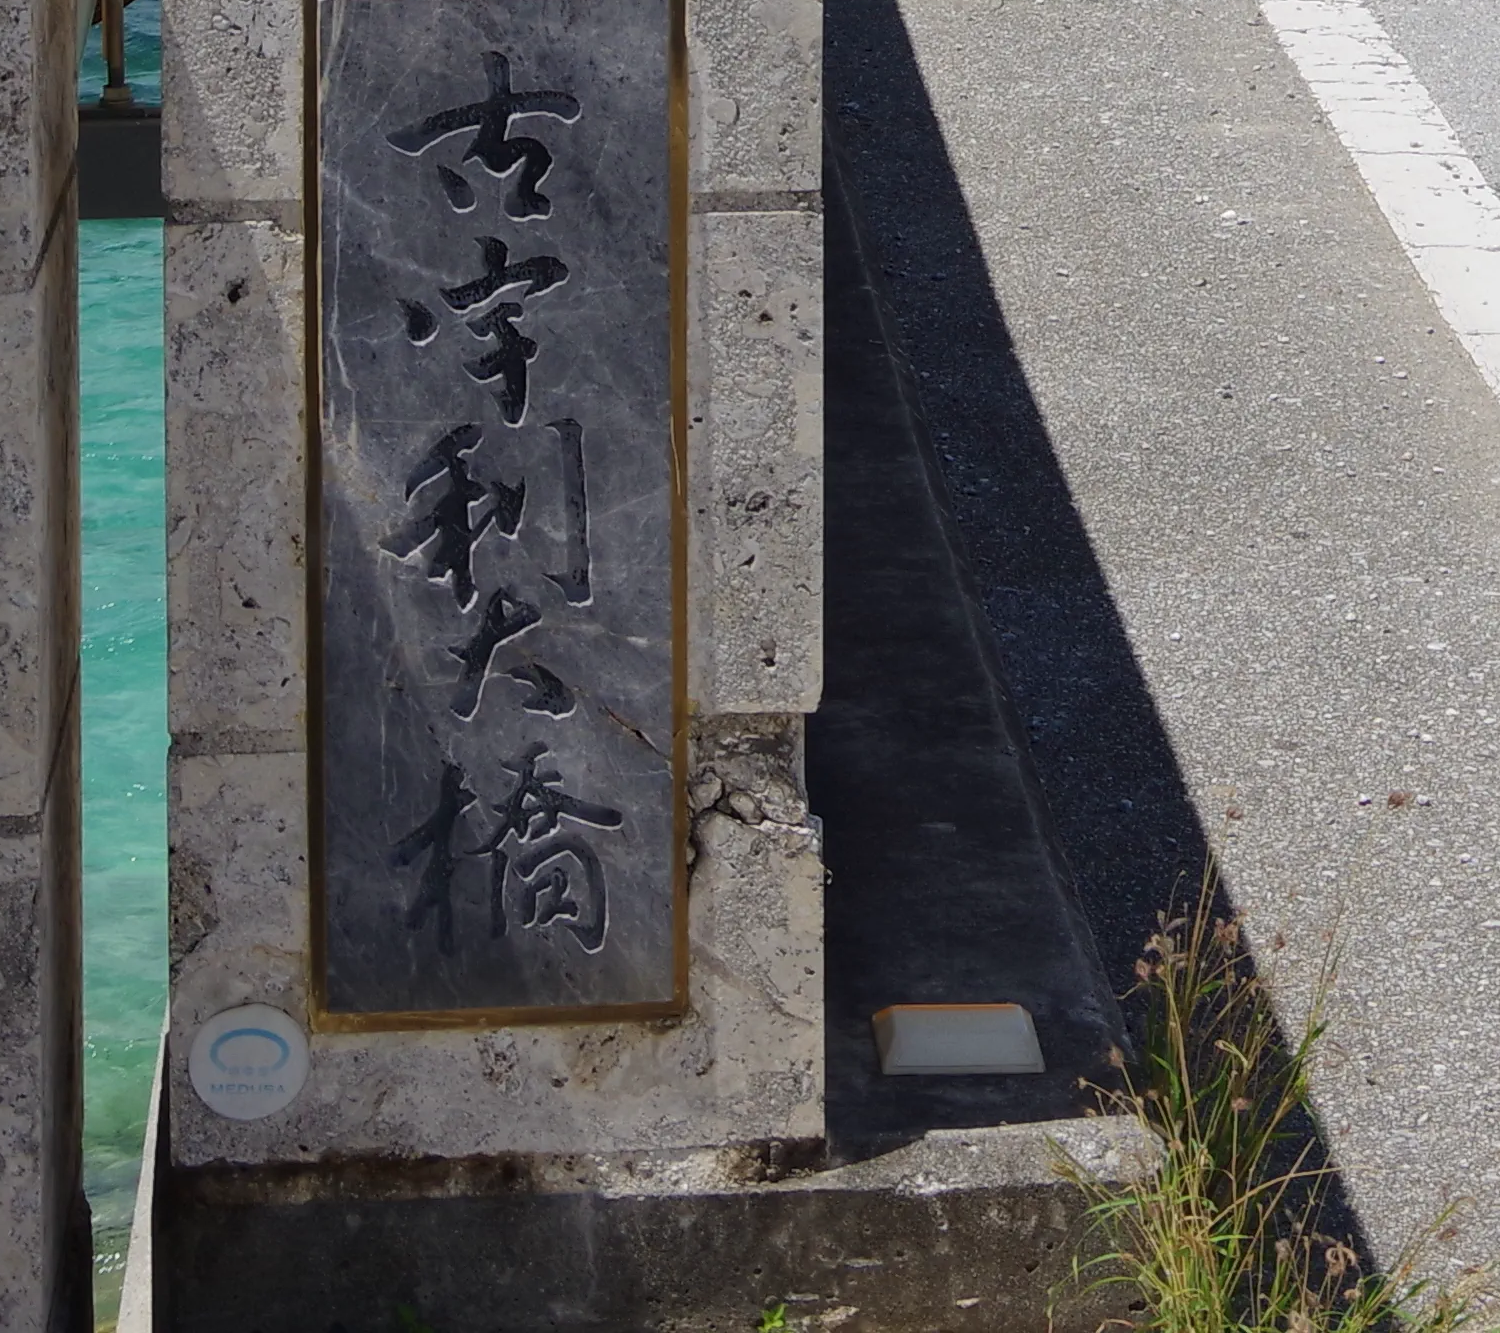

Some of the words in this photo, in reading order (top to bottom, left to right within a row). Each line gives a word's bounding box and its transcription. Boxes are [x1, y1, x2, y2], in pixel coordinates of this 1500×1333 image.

[378, 49, 624, 956] 古宇利大橋
[210, 1083, 286, 1095] MEDUSA
